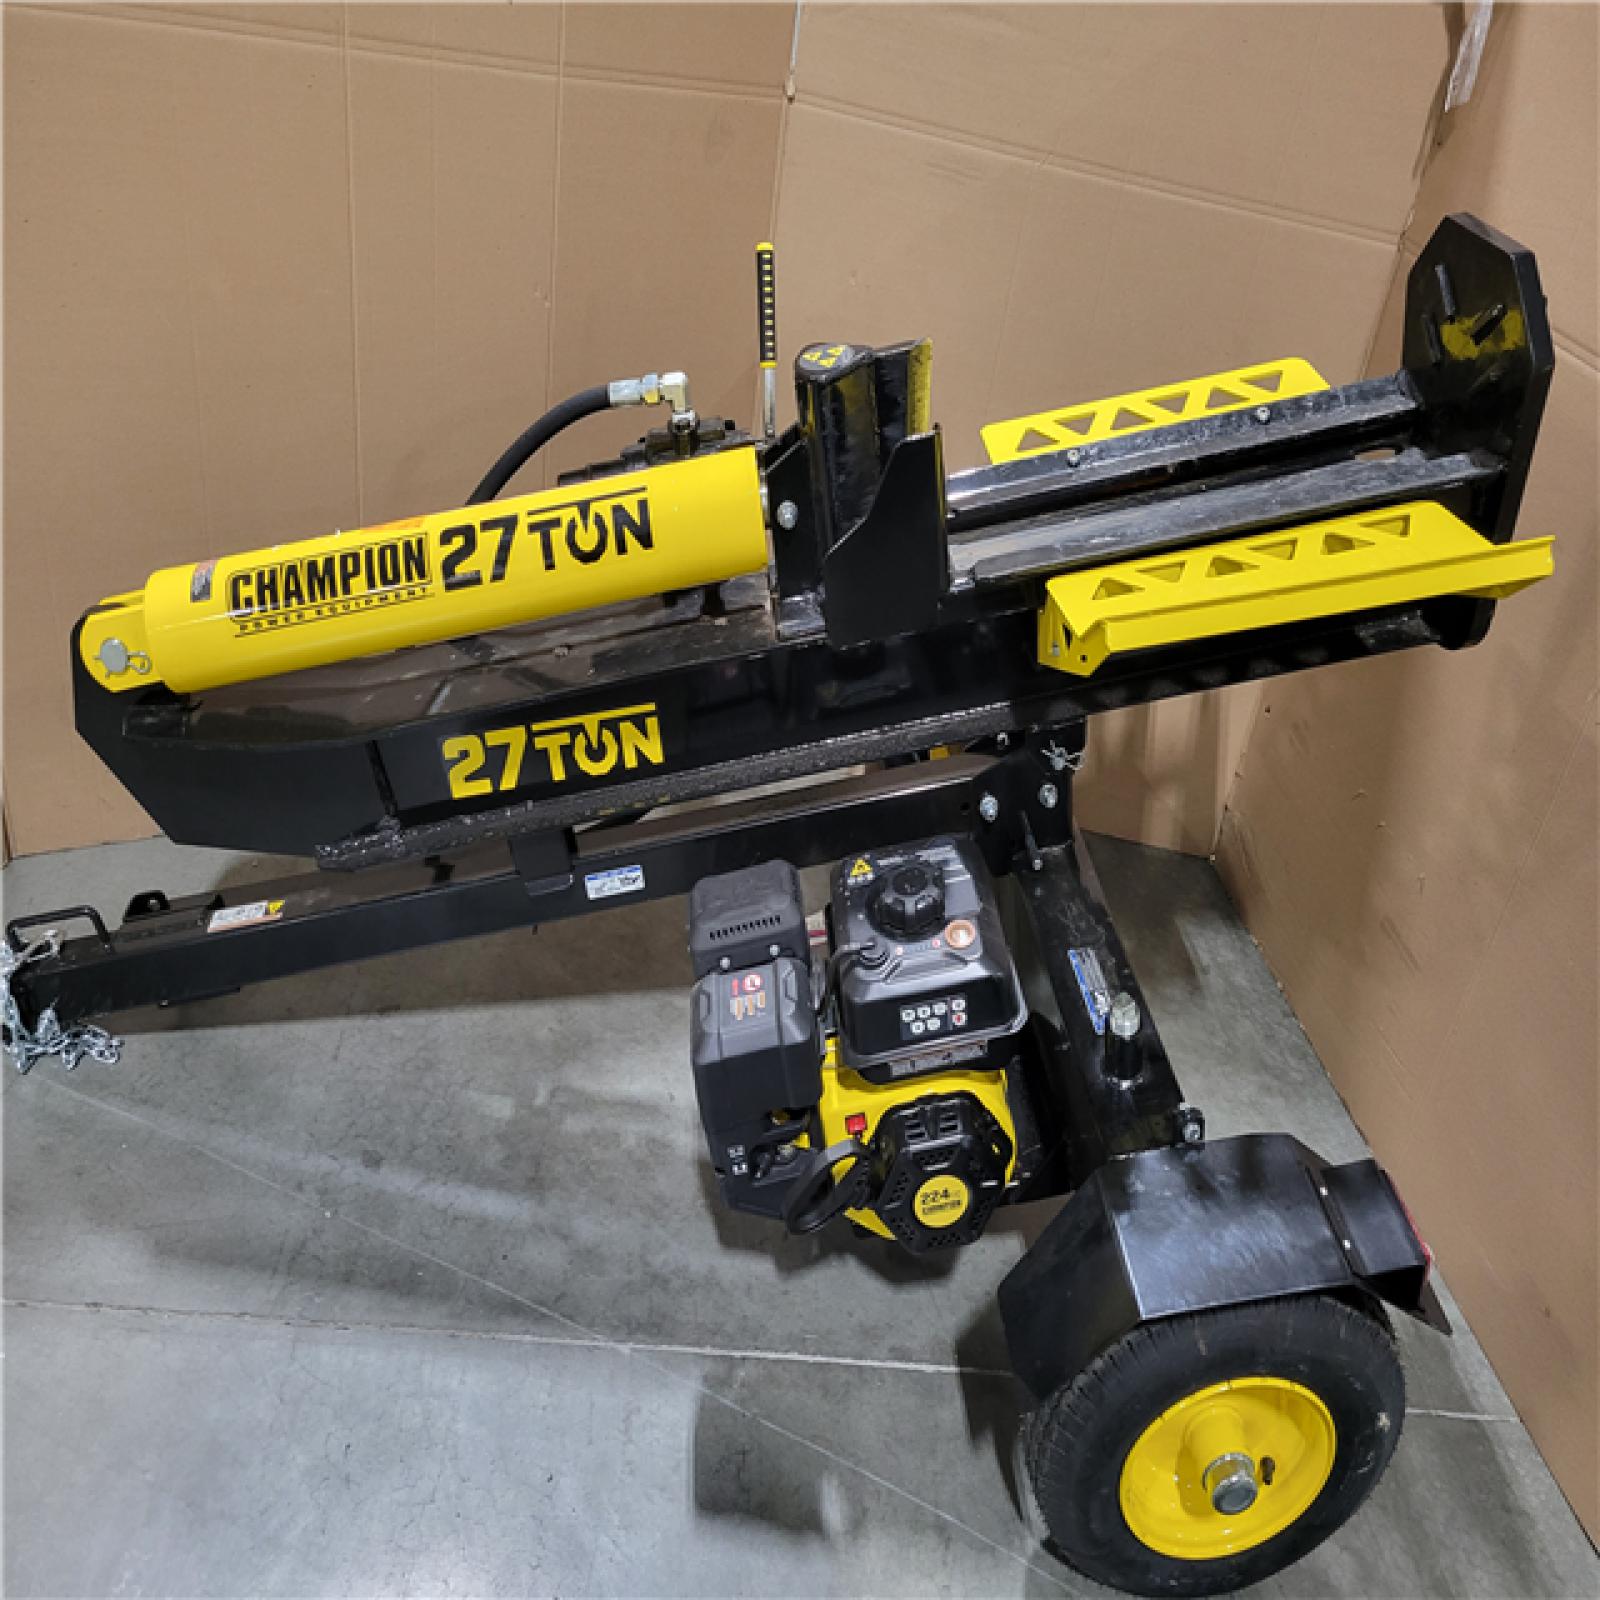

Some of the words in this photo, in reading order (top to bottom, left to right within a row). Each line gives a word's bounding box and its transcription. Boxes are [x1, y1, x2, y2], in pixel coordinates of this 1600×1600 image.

[232, 535, 426, 616] CHAMPION
[440, 514, 518, 592] 27
[526, 487, 653, 571] TON
[442, 724, 526, 798] 27
[531, 702, 664, 781] TON
